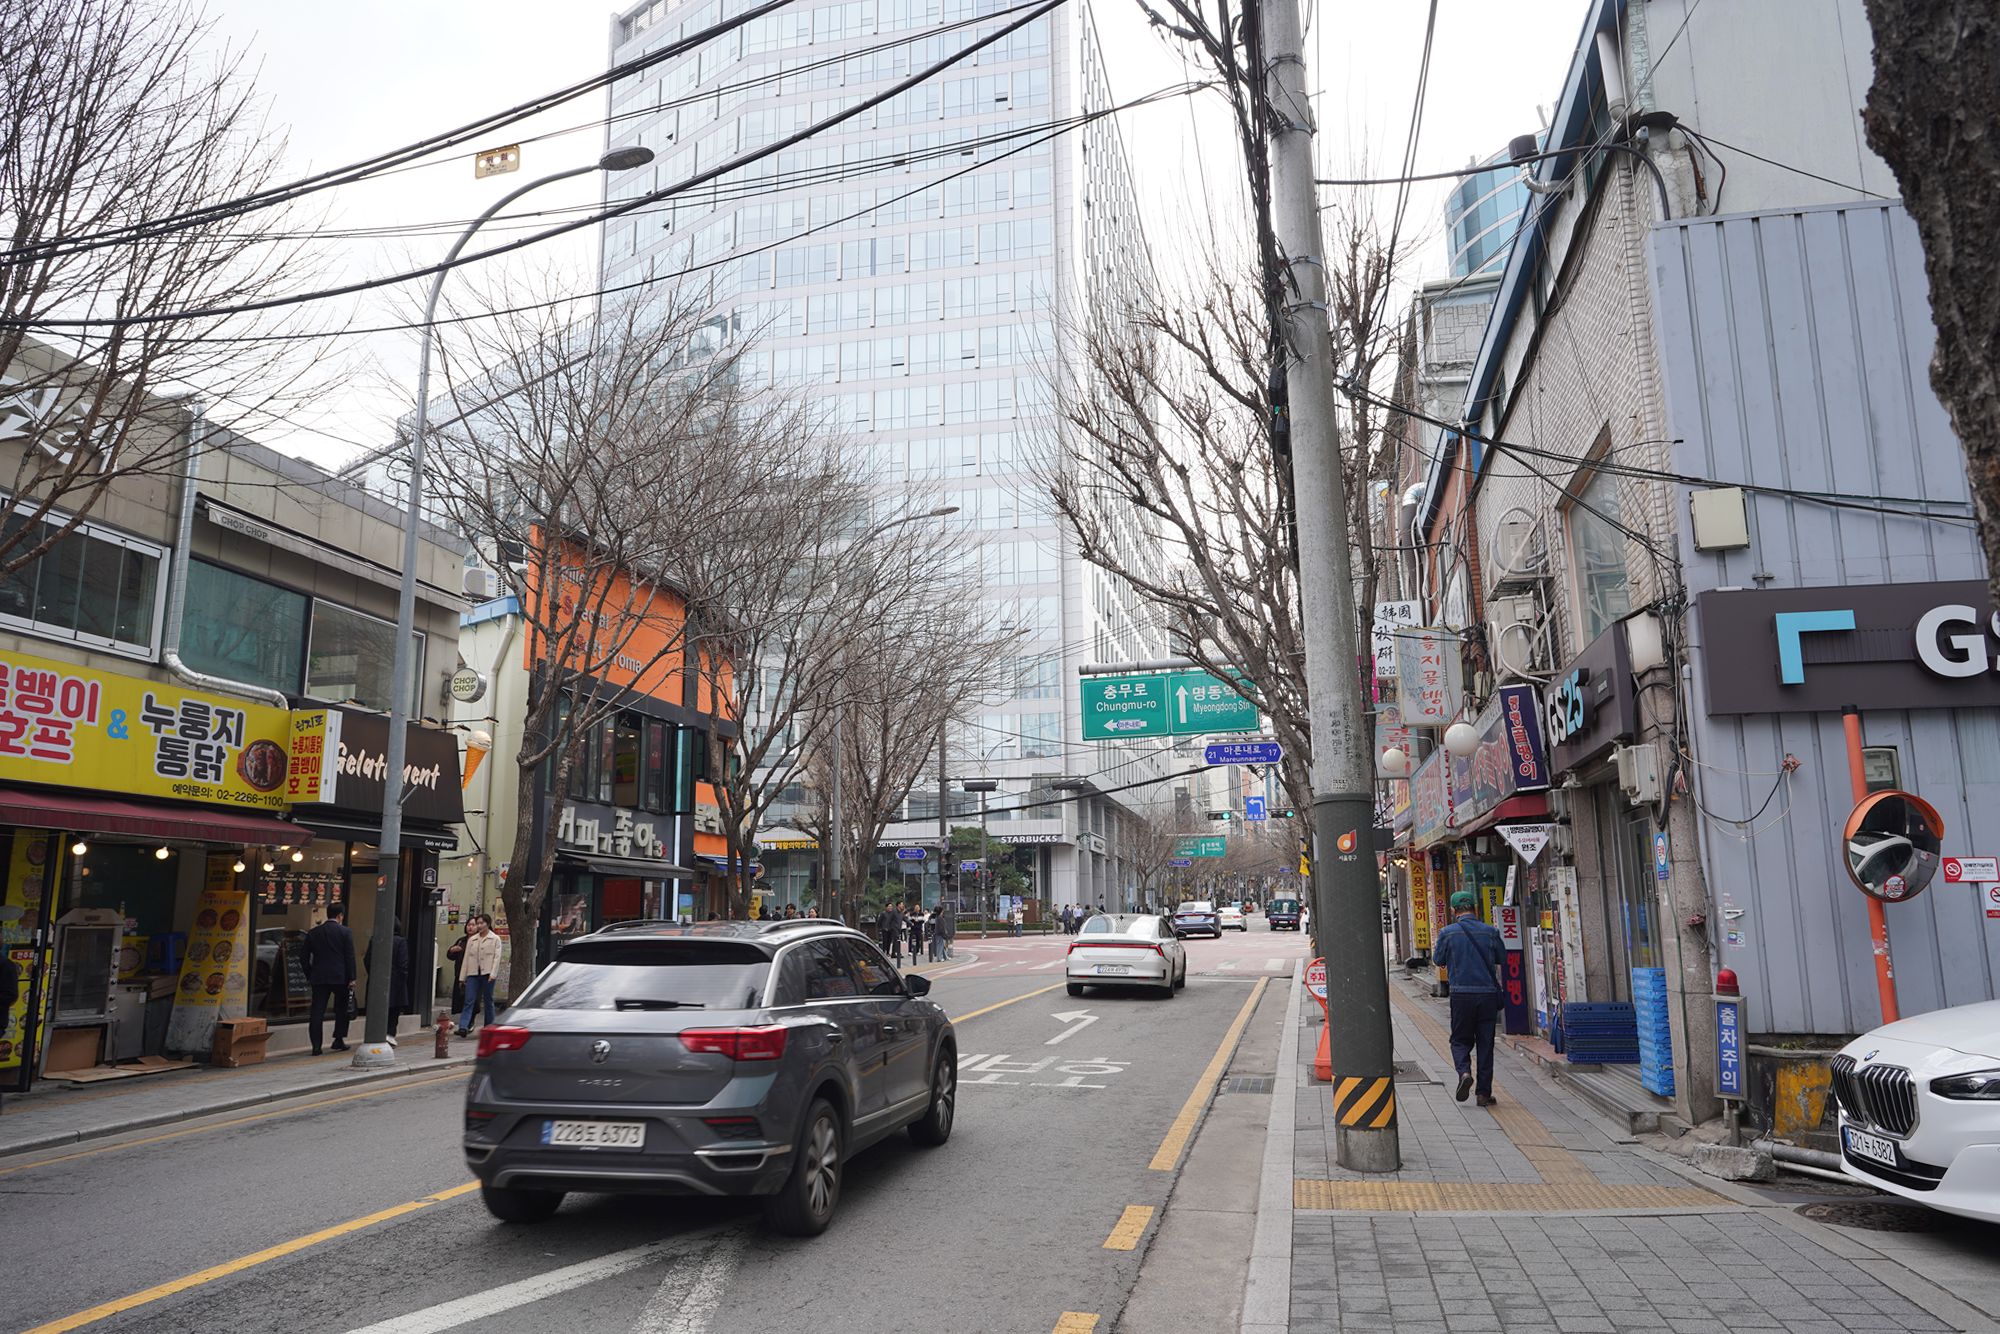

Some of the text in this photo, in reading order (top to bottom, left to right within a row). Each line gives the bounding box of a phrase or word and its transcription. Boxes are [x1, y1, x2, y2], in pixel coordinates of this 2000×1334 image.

[221, 515, 268, 539] CHOP CHOP
[1915, 604, 2000, 678] G
[452, 684, 476, 692] CHOP
[453, 677, 477, 685] CHOP
[1103, 682, 1148, 700] 충무로
[0, 664, 99, 723] 뱅이
[1192, 685, 1238, 701] 명동역
[1096, 700, 1157, 713] Chungmu-ro
[1193, 702, 1238, 714] Myeongdong
[1547, 668, 1587, 748] GS25
[107, 708, 129, 740] &
[141, 694, 245, 748] 누룽지
[1507, 694, 1538, 781] 뱅뱅골뱅이
[156, 736, 226, 783] 통닭
[1207, 745, 1278, 759] 21 마른내로 17
[1219, 755, 1267, 763] Mareunnae-ro
[290, 756, 321, 775] 골뱅이
[216, 790, 284, 808] 02-2266-1100
[1001, 835, 1058, 843] STARBUCKS
[1501, 908, 1518, 940] 원조
[1506, 952, 1523, 1006] 뱅뱅
[1720, 1007, 1738, 1090] 출차주의
[601, 1124, 642, 1144] 6373
[1850, 1131, 1894, 1162] 321누 6382
